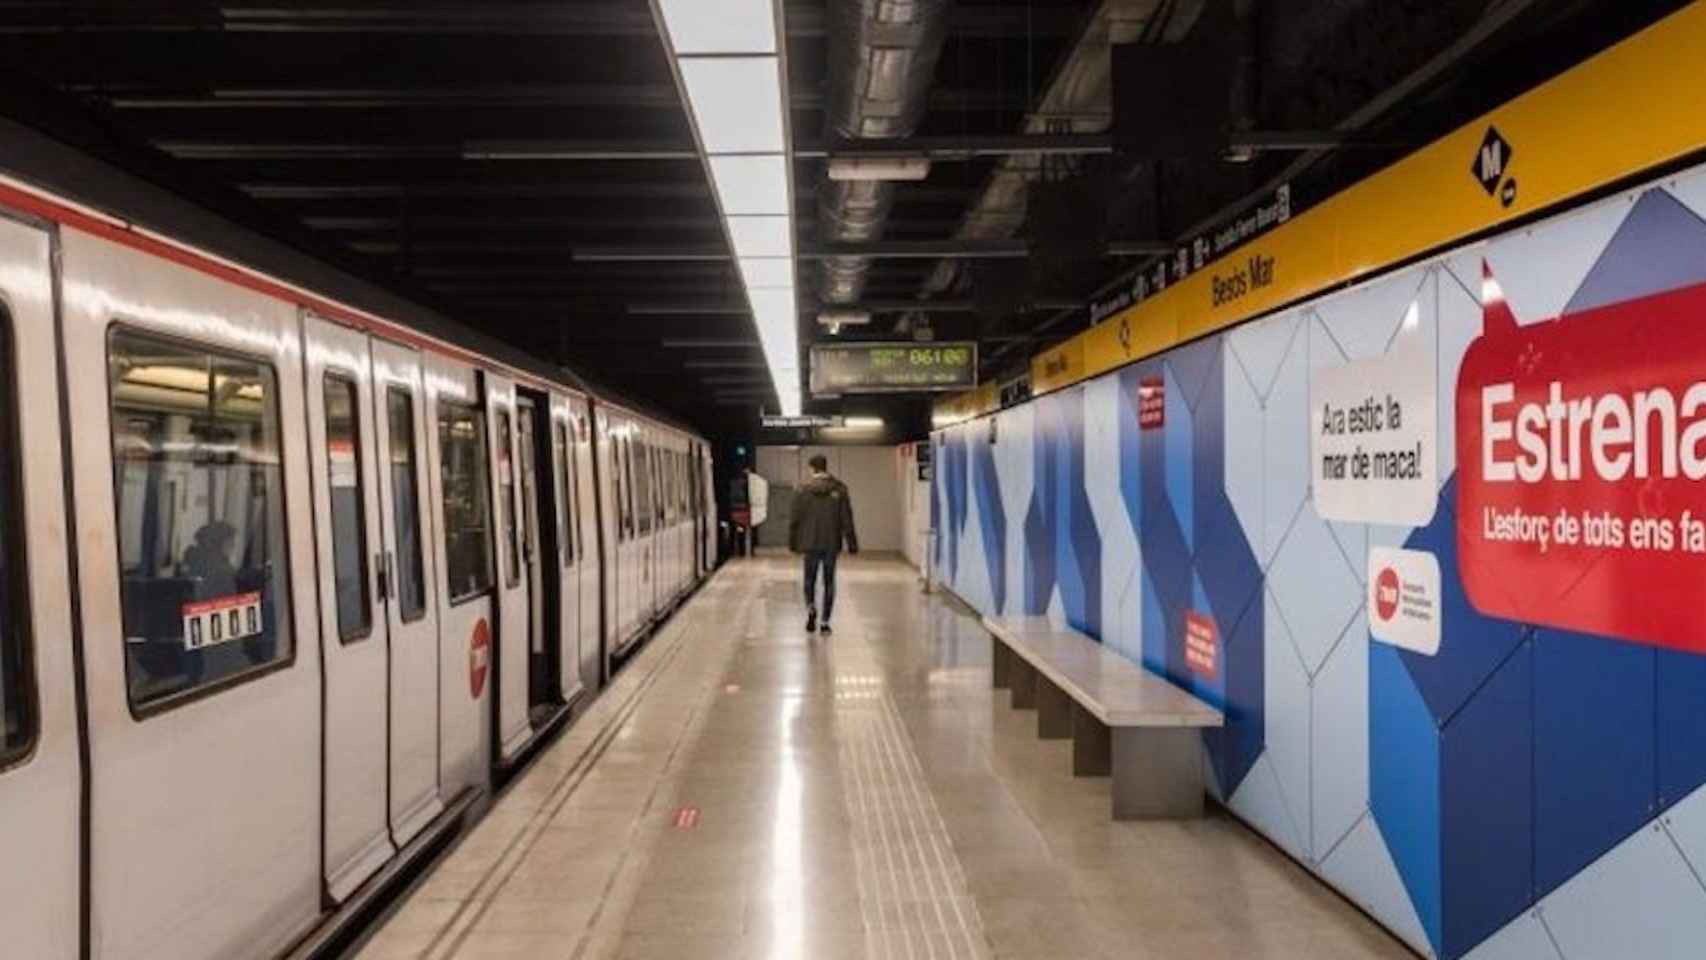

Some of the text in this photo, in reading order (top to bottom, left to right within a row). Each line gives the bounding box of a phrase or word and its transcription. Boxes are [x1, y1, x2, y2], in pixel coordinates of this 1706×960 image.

[1481, 139, 1502, 182] M
[1249, 254, 1275, 290] Mar
[1321, 393, 1402, 436] Ara estic la
[1481, 380, 1706, 484] Estrena
[1322, 440, 1422, 480] mar de maca!
[1483, 506, 1549, 553] L'esforç
[1553, 508, 1580, 545] de
[1583, 511, 1625, 549] tots
[1630, 516, 1674, 550] ens
